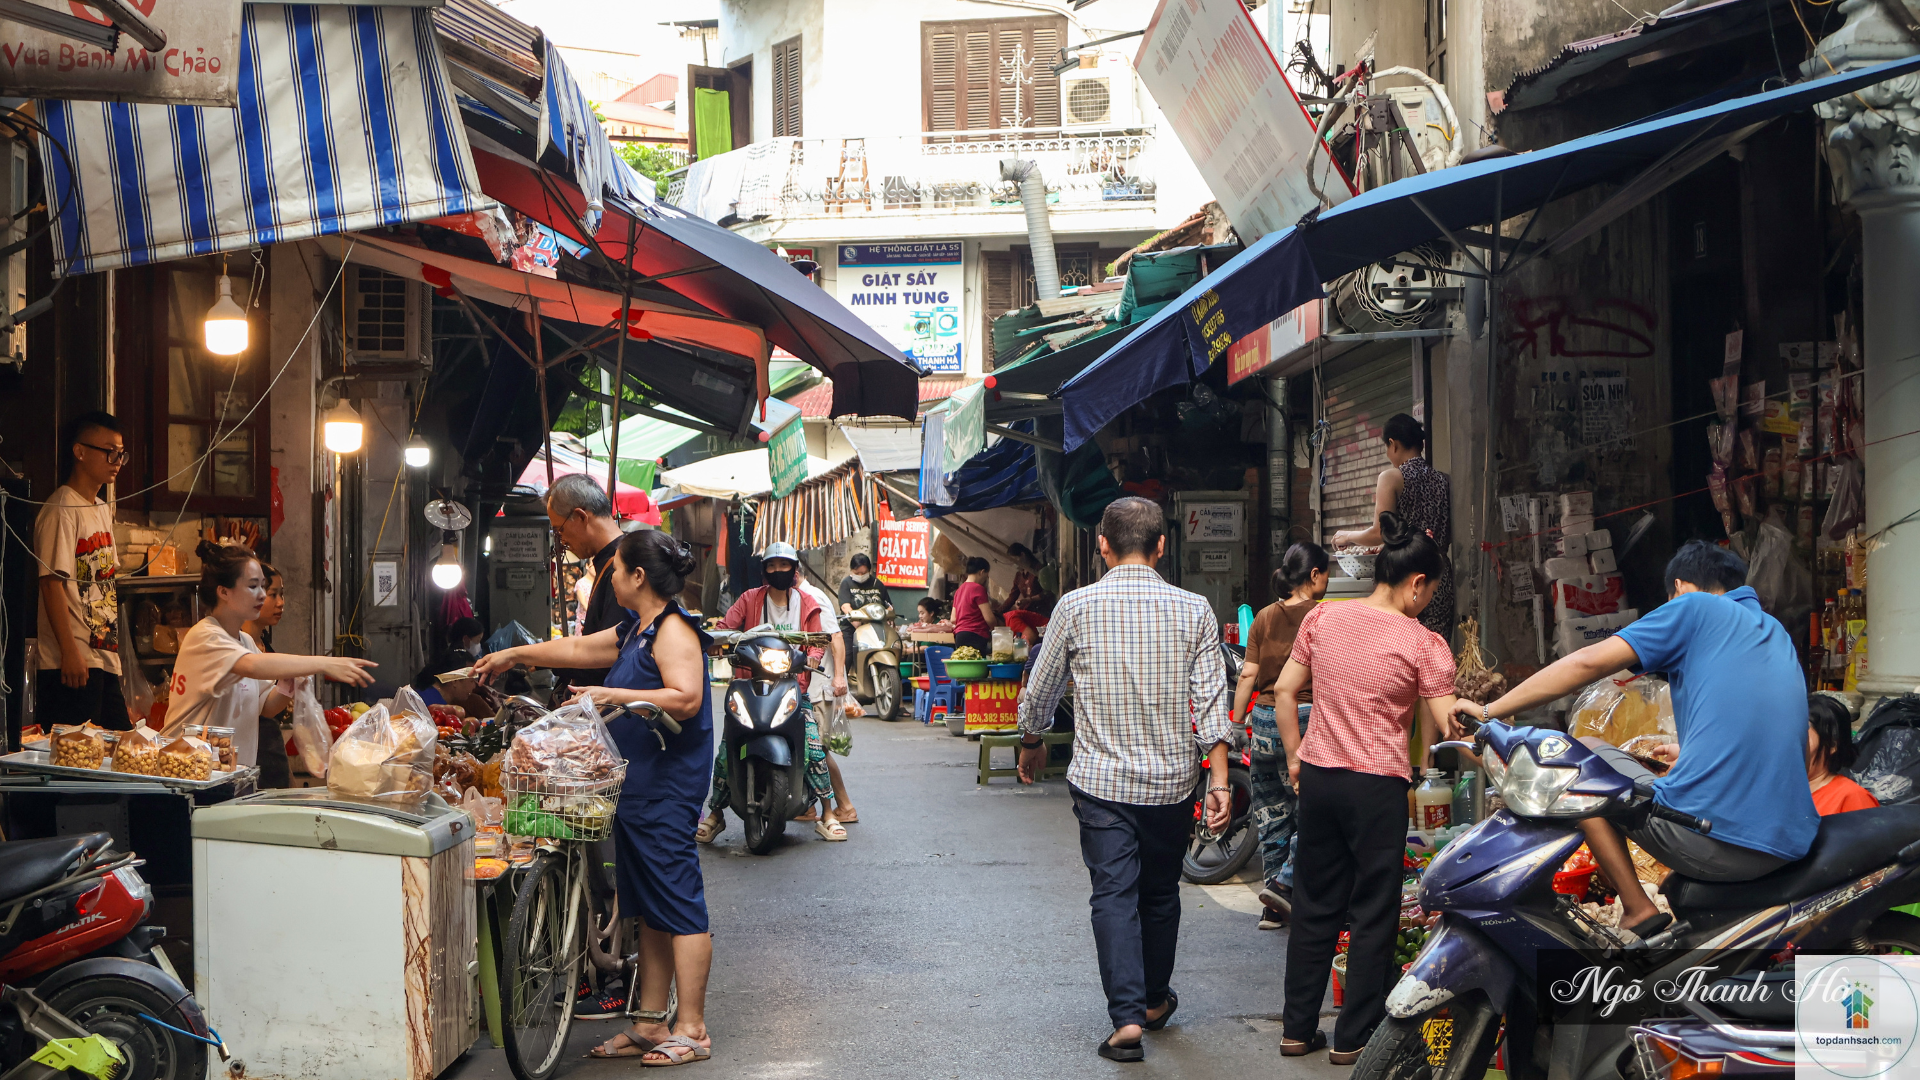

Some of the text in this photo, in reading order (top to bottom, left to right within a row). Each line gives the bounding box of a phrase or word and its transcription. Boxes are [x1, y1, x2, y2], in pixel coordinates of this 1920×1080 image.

[2, 42, 50, 69] Vua
[57, 43, 115, 73] Bánh
[163, 47, 221, 77] Chảo
[1219, 14, 1273, 99] CHỌN
[914, 243, 934, 253] GIẶT
[936, 242, 947, 251] LÀ
[862, 268, 937, 290] GIẶT SẤY
[851, 288, 949, 306] MINH TÙNG
[918, 355, 959, 365] THANH HÀ
[1582, 378, 1605, 401] SỬA
[881, 520, 928, 533] LAUNDRY SERVICE
[879, 532, 927, 561] GIẶT LÀ
[878, 560, 925, 577] LẤY NGAY
[772, 623, 793, 631] ANEL
[1481, 916, 1517, 926] HONDA
